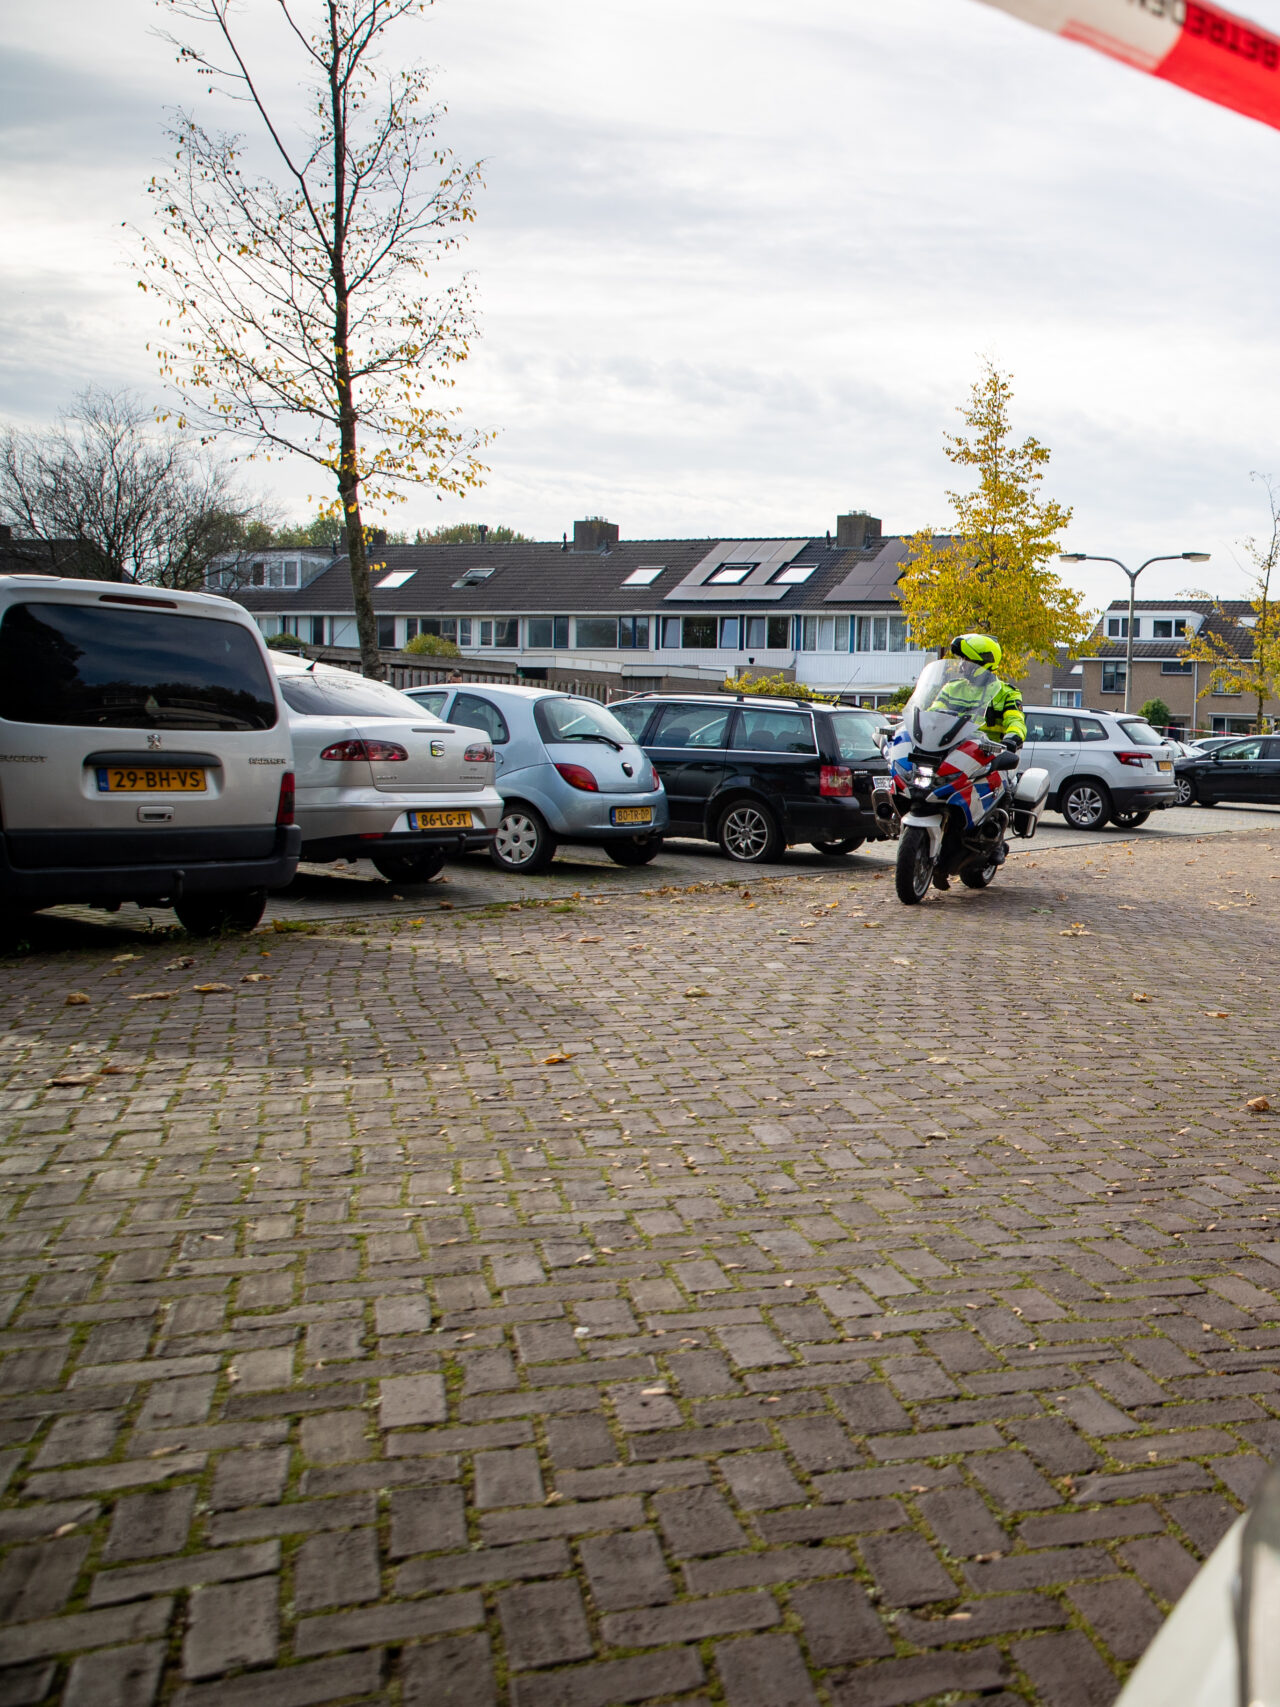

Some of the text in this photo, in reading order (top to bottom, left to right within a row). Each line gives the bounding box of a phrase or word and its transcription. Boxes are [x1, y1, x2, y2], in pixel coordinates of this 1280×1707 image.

[1130, 0, 1280, 70] BETREDE
[113, 770, 201, 788] 29-BH-VS
[421, 813, 467, 827] 86-LG-JT
